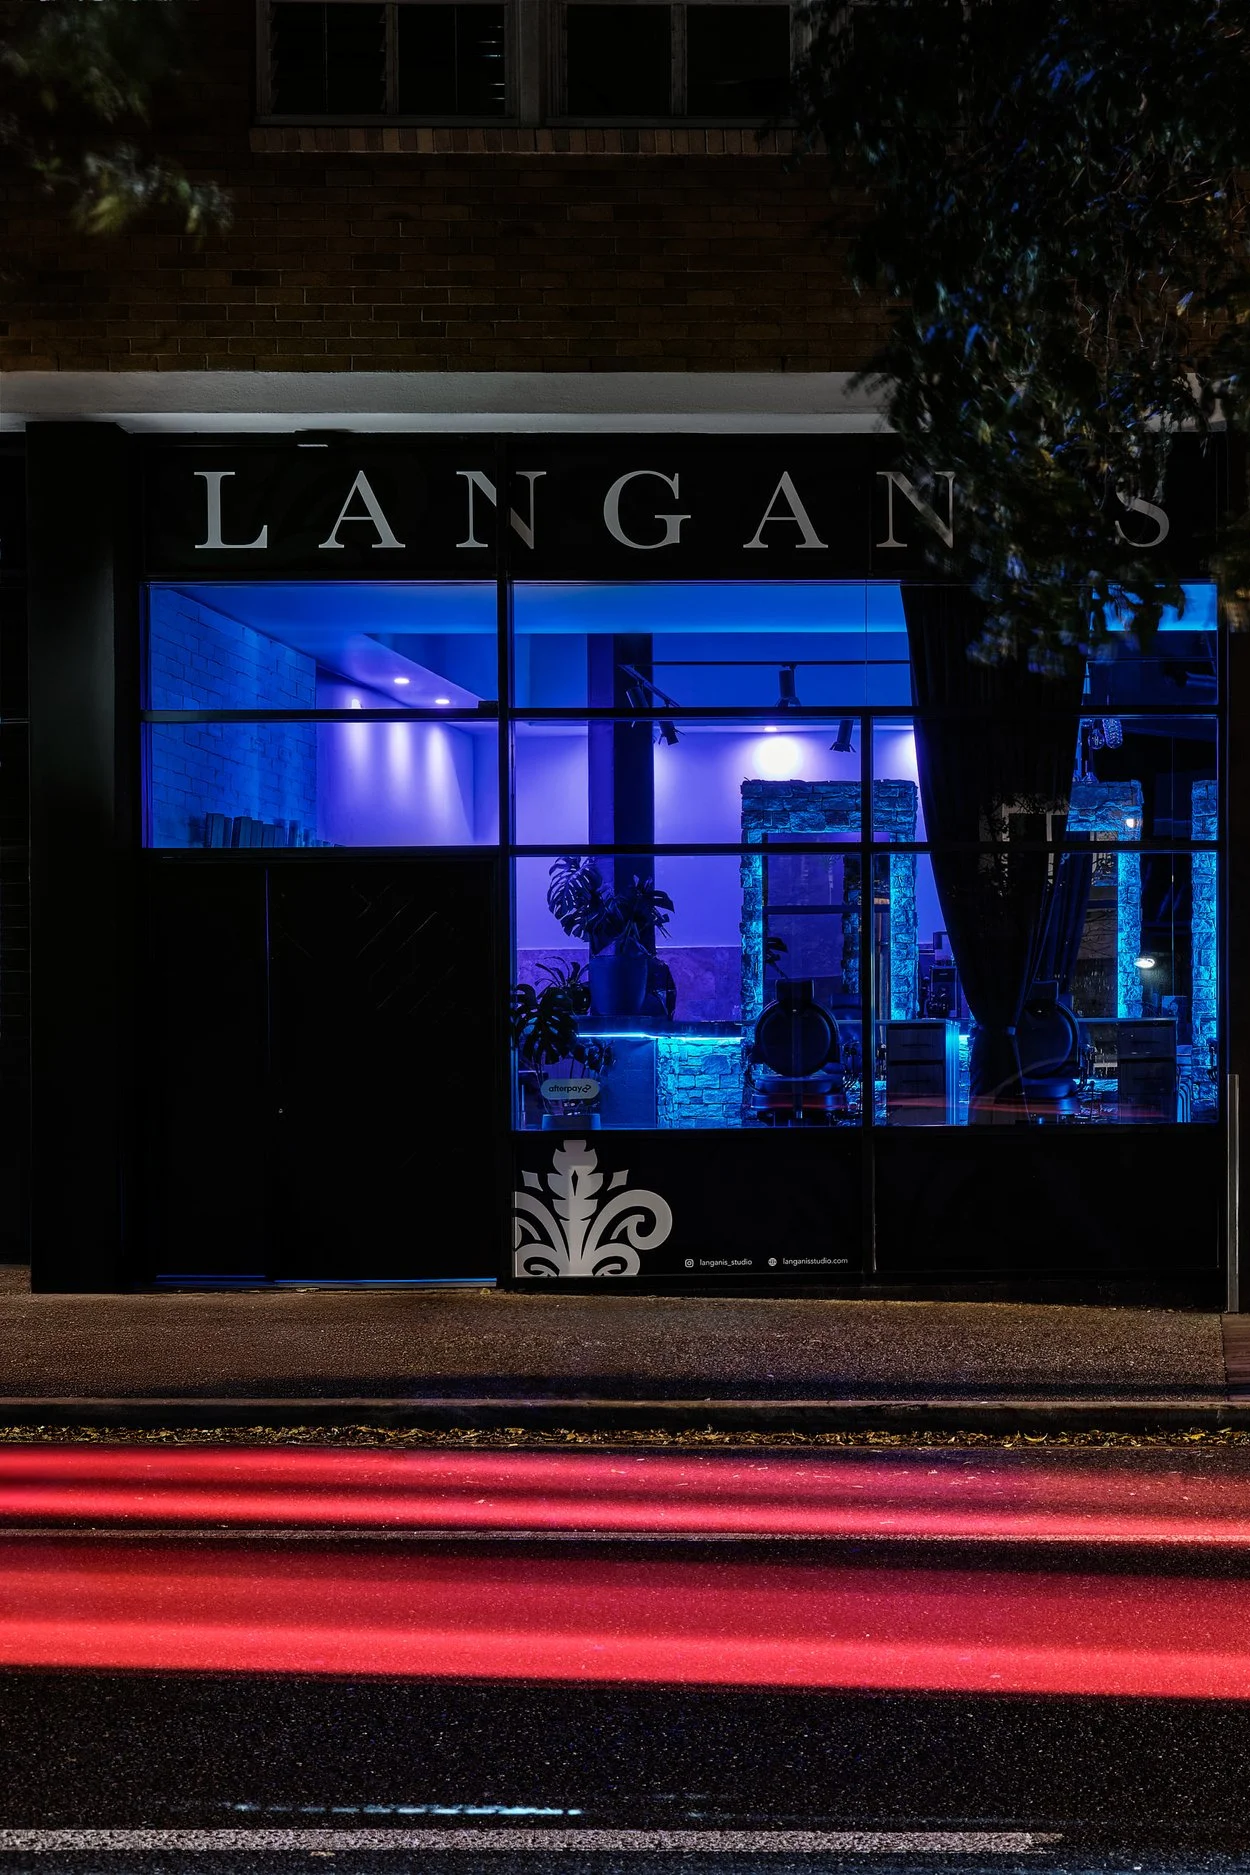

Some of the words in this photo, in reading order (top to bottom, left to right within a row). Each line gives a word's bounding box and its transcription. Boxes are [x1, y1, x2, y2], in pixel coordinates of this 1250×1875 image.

[194, 469, 1171, 549] LANGANS
[548, 1084, 583, 1094] afterpay
[699, 1257, 753, 1268] langanis_studio
[782, 1256, 849, 1267] langanisstudio.com
